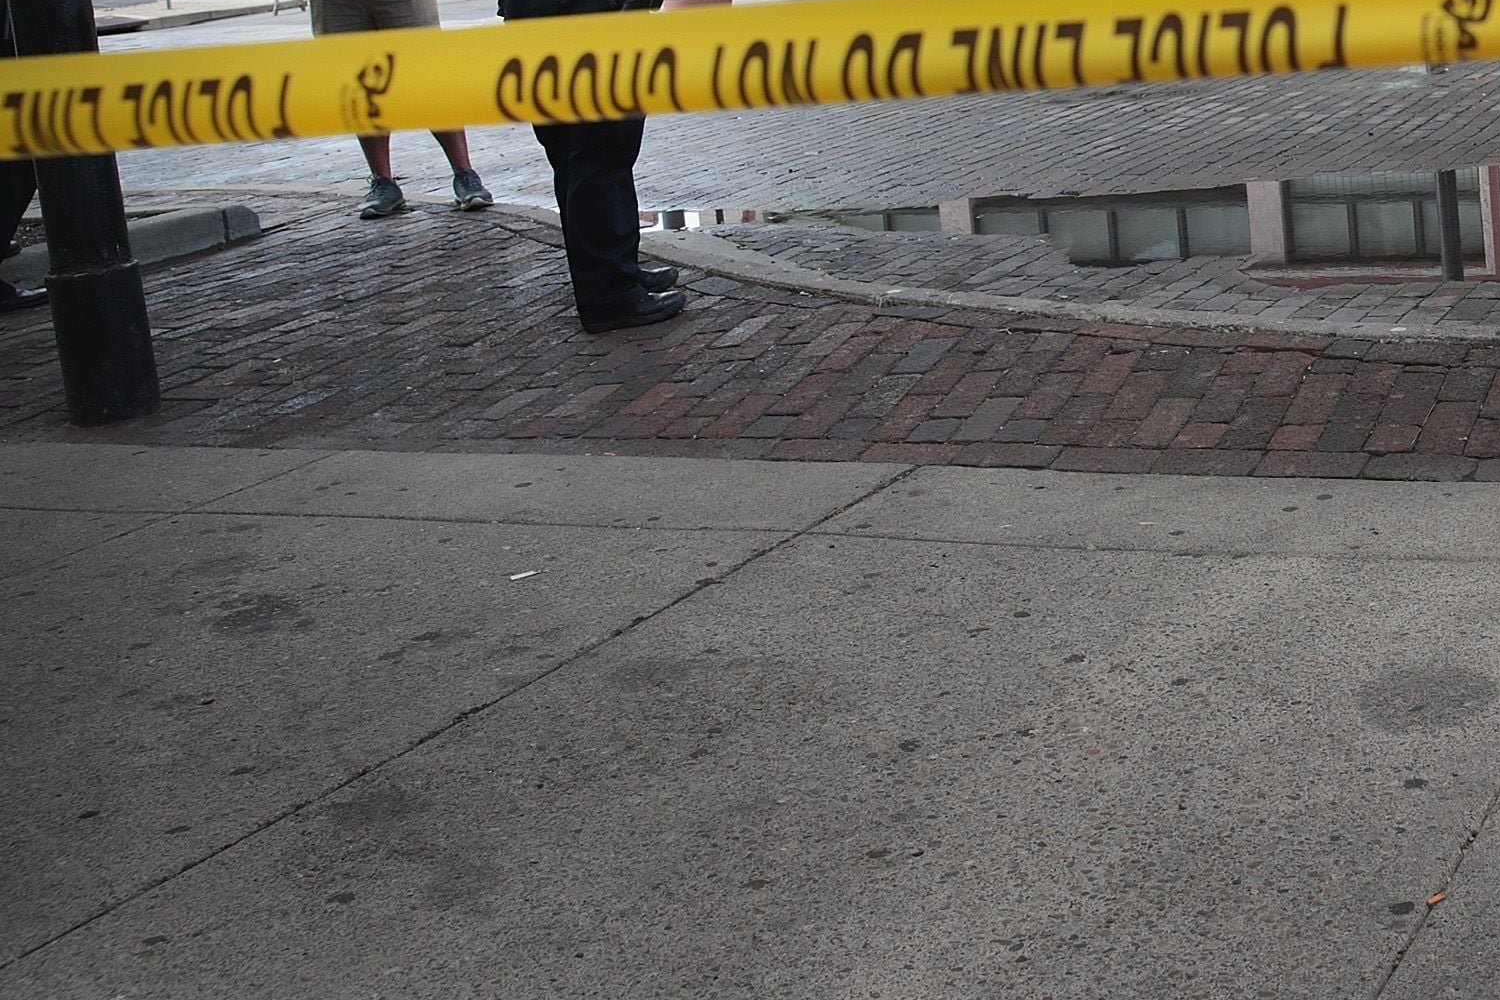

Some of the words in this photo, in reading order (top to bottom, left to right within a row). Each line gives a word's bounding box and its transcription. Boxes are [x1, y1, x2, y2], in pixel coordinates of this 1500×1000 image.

[713, 39, 820, 108] NOT
[842, 31, 925, 98] DO
[951, 19, 1088, 92] LINE
[1113, 4, 1350, 82] POLICE
[496, 46, 687, 122] CROSS
[2, 86, 113, 155] LINE
